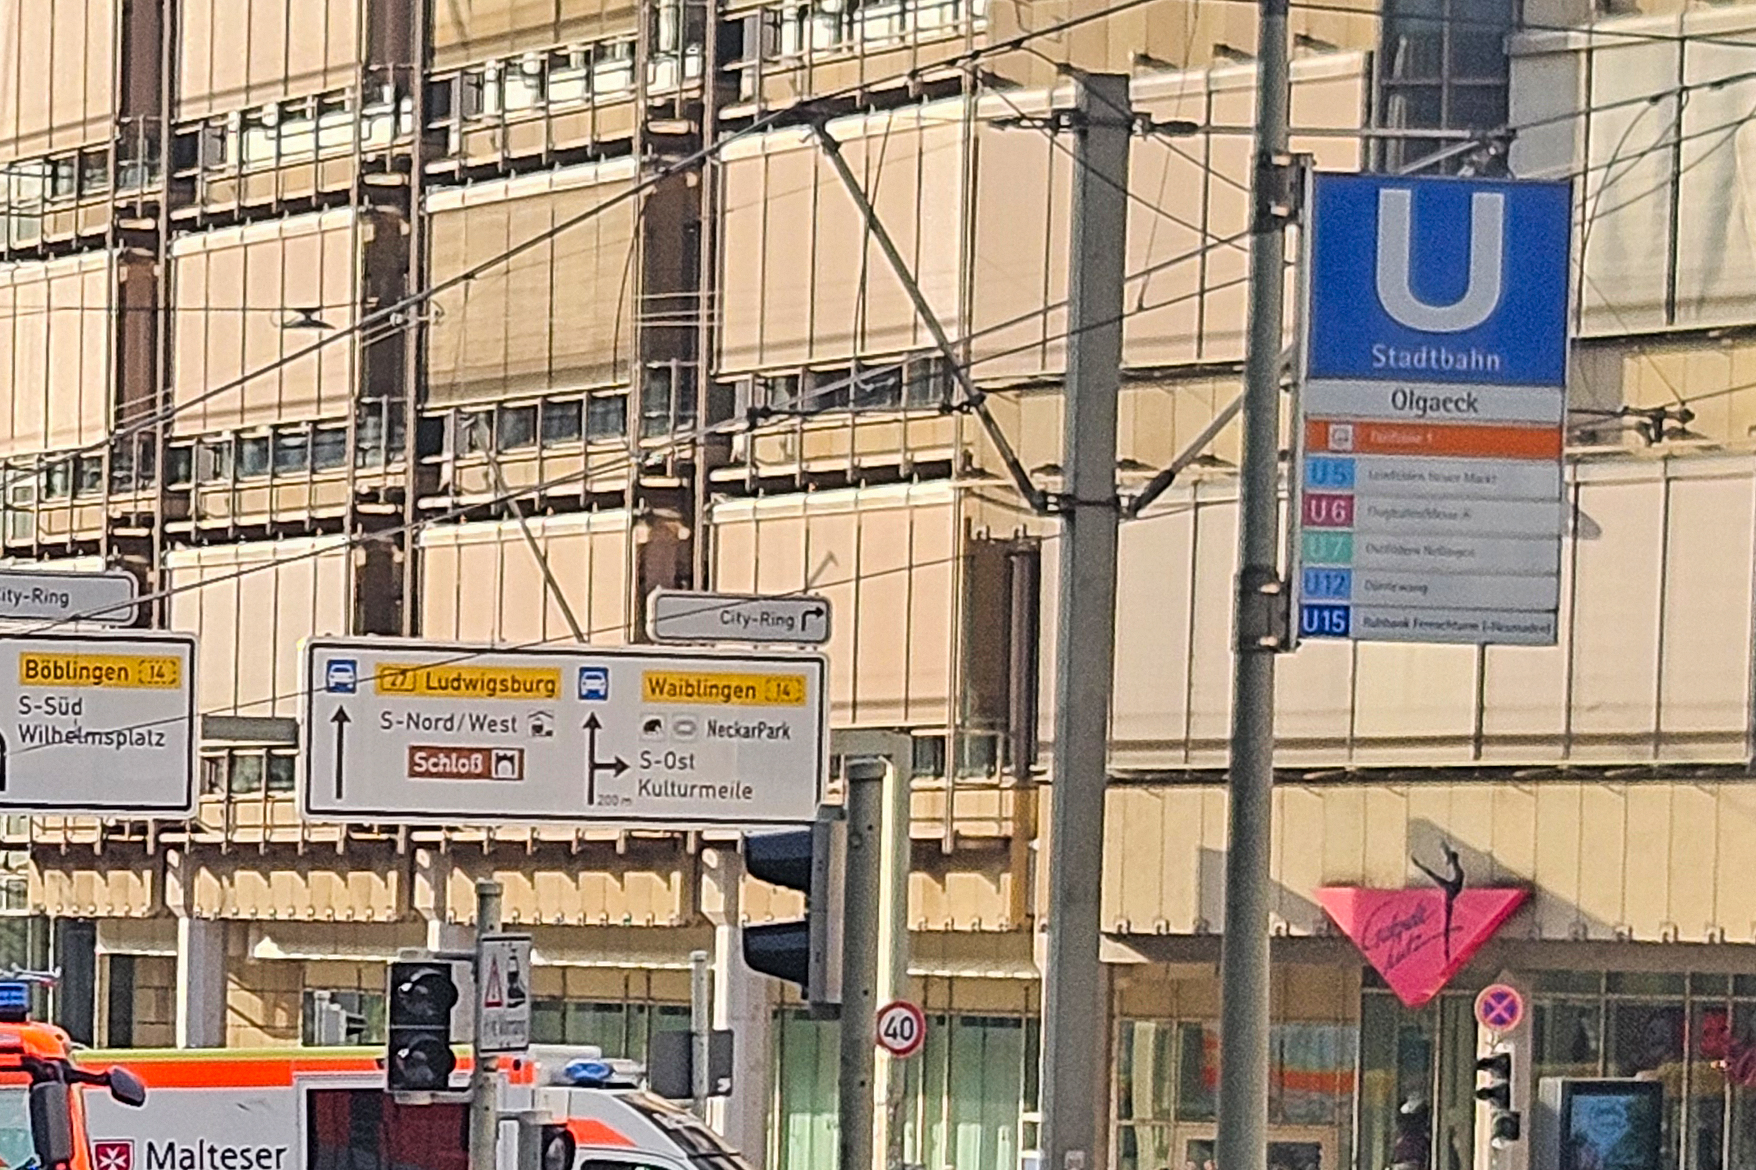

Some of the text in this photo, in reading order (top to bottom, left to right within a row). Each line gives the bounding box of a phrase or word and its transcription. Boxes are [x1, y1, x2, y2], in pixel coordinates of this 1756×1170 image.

[1377, 188, 1505, 333] U
[1372, 343, 1502, 373] Stadtbahn
[1391, 387, 1479, 417] Olgaeck
[1304, 571, 1345, 597] U12
[720, 610, 795, 629] City-Ring
[1303, 609, 1345, 633] U15
[25, 659, 165, 685] Böblingen 14
[426, 672, 557, 698] Ludwigsburg
[648, 677, 791, 702] Waiblingen 14
[19, 695, 83, 716] S-Süd
[381, 710, 518, 733] S-Nord/West
[707, 719, 791, 740] NeckarPark
[19, 724, 165, 750] Wilhelmsplatz
[412, 751, 484, 774] Schloß
[639, 750, 695, 771] S-Ost
[638, 778, 754, 801] Kulturmeile
[883, 1016, 915, 1041] 40
